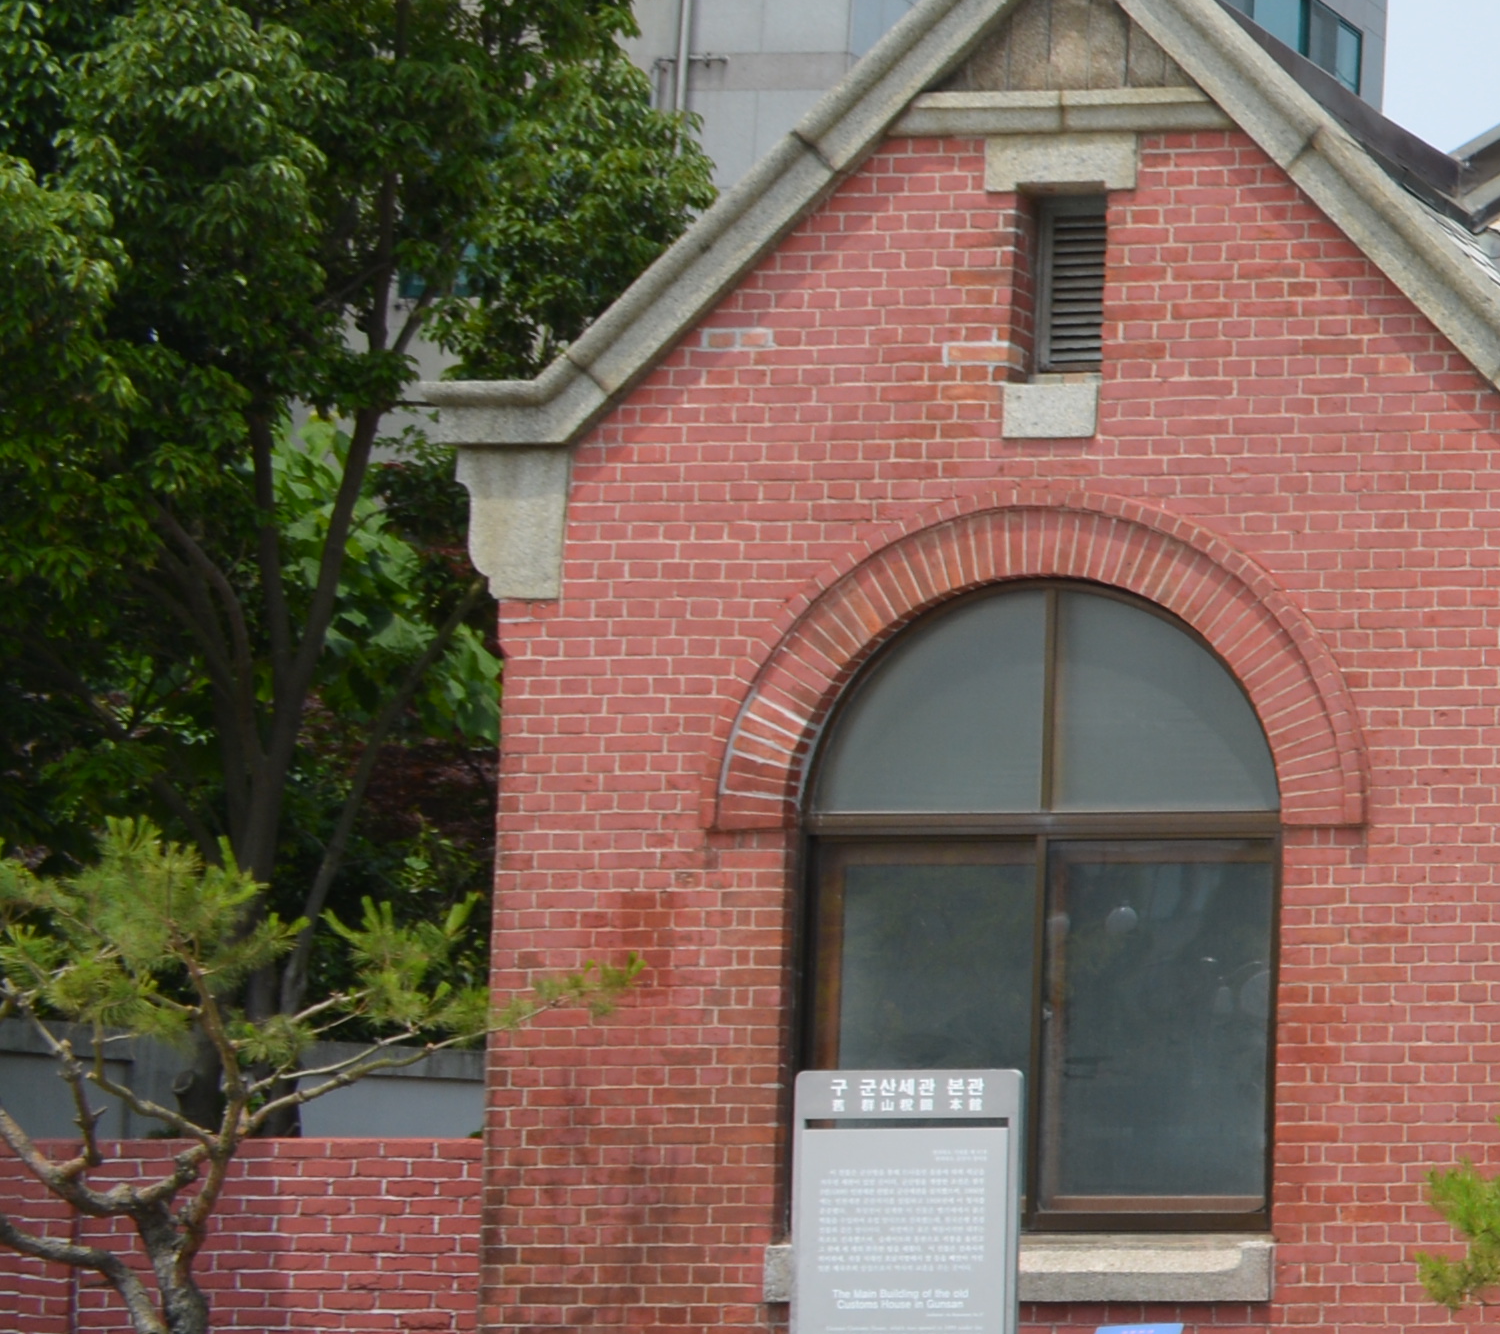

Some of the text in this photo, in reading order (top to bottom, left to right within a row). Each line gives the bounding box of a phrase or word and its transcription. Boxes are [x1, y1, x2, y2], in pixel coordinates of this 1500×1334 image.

[830, 1078, 984, 1096] 구 군산세관 본관
[832, 1288, 969, 1300] The Main Building of the old
[837, 1299, 964, 1309] Customs House in Gunsan
